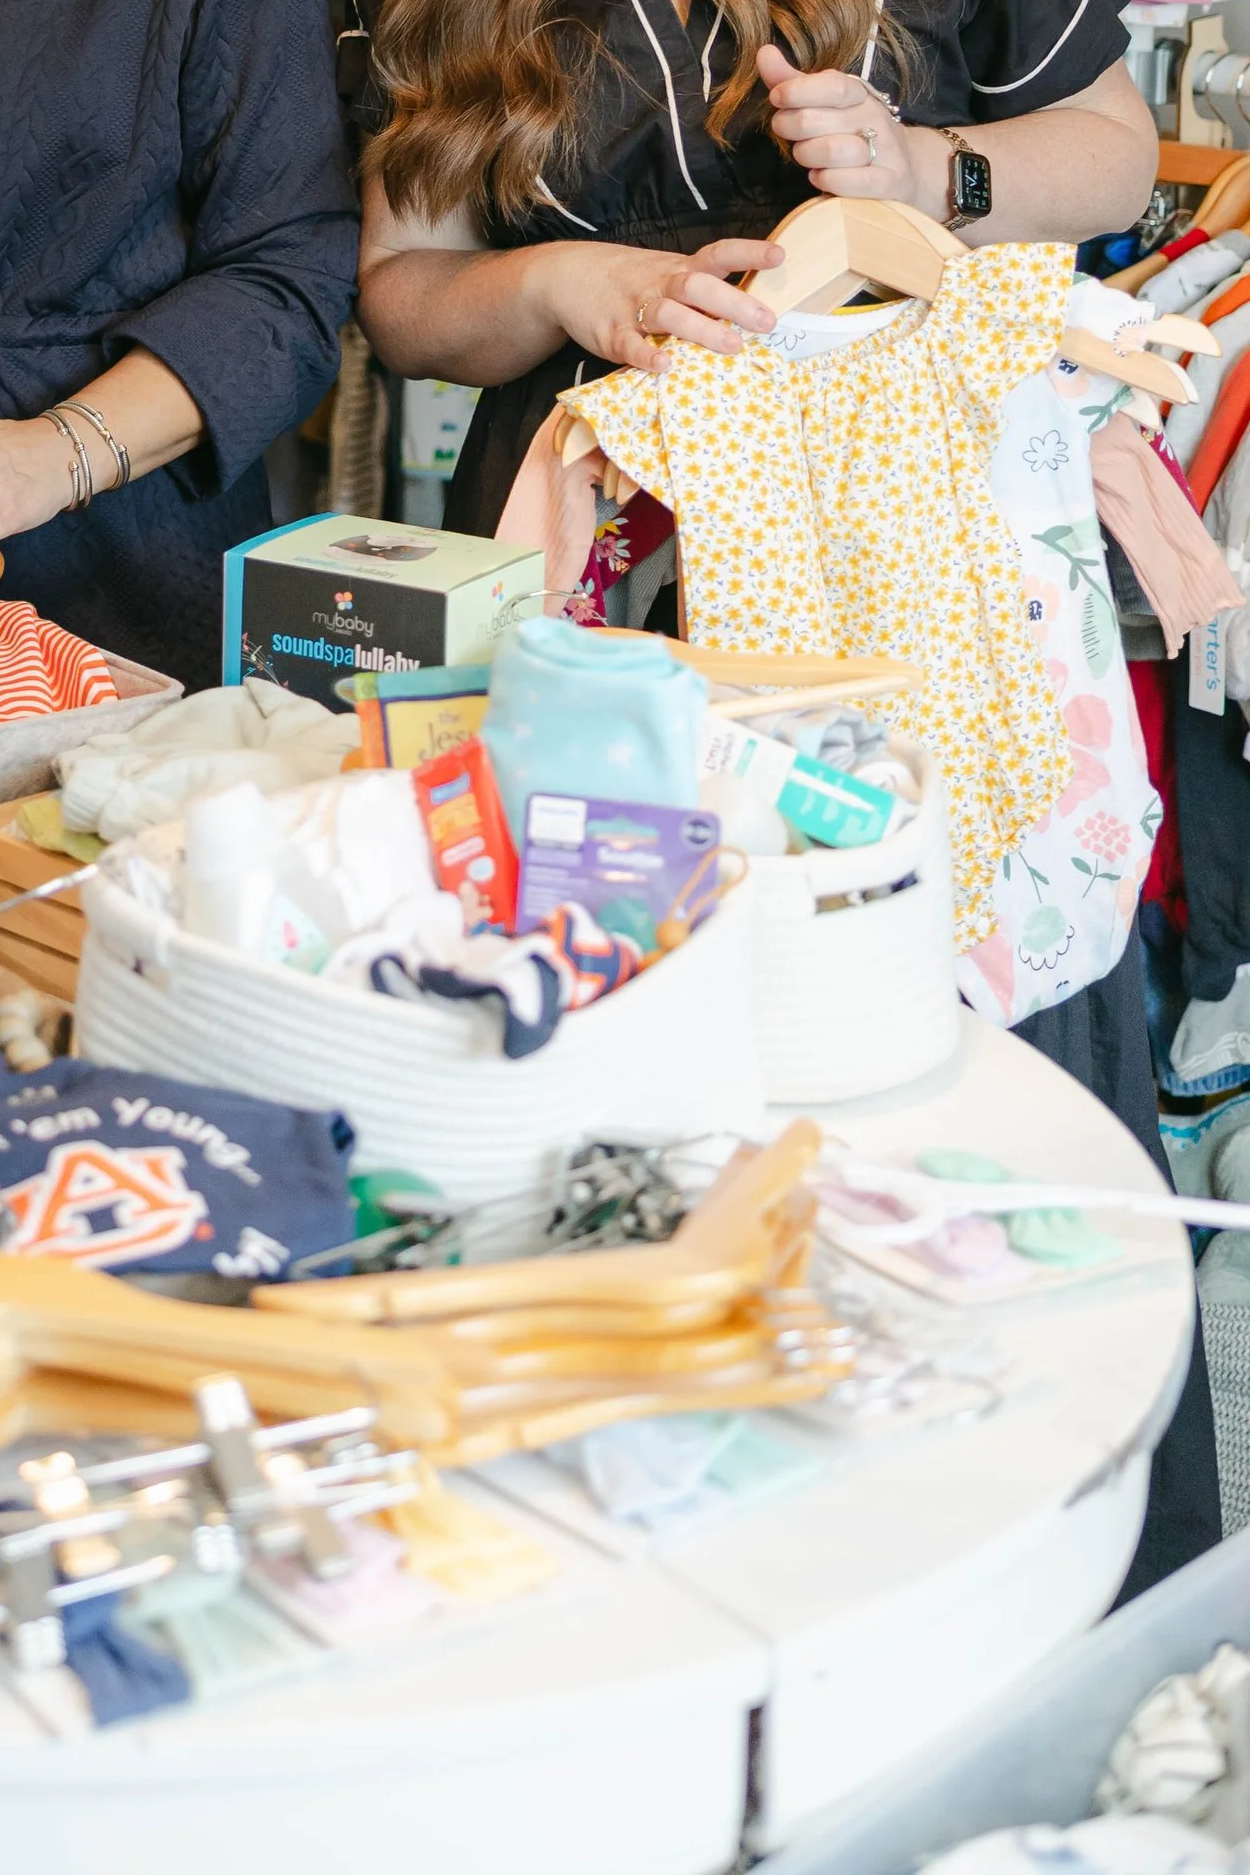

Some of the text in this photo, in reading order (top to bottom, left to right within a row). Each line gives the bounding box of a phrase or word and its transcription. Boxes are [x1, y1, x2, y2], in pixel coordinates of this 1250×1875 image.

[311, 610, 374, 638] mybaby
[271, 632, 421, 673] soundspalullaby
[1205, 616, 1221, 691] arter's
[417, 722, 480, 763] Jes
